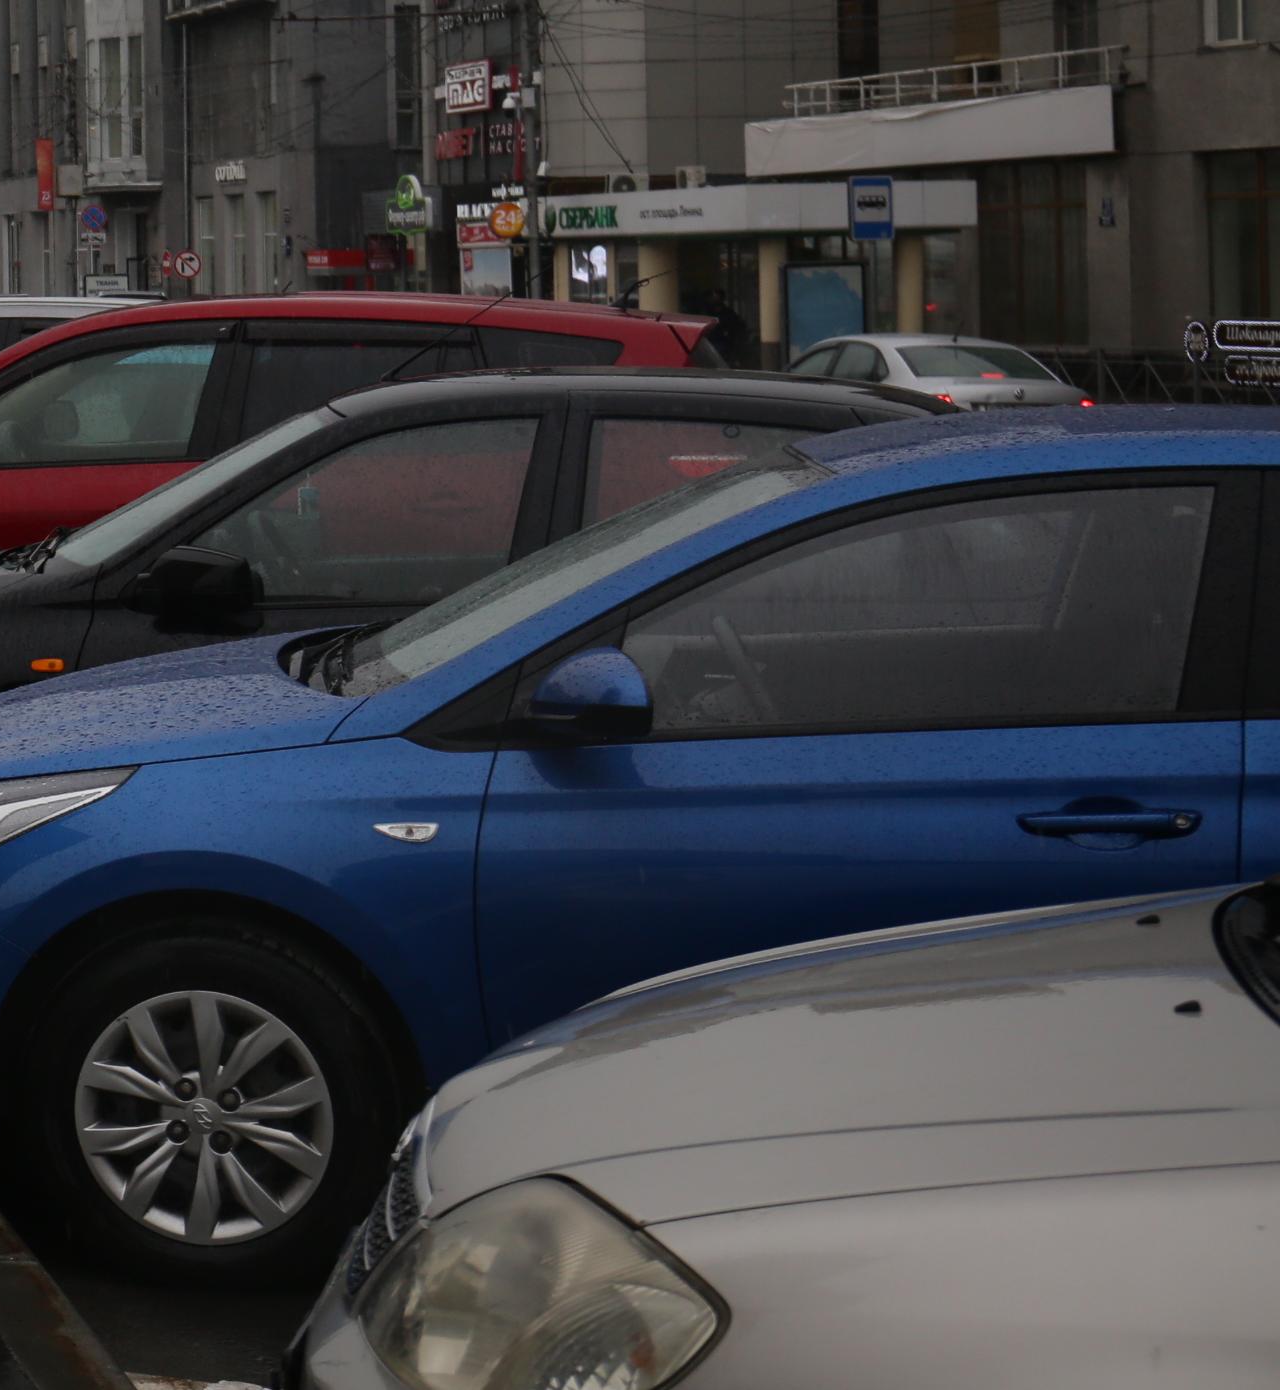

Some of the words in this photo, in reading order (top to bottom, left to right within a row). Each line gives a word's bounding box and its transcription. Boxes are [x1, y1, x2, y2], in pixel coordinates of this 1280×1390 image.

[489, 140, 503, 154] НА
[495, 209, 516, 224] 24
[559, 205, 618, 230] СБЕРБАНК
